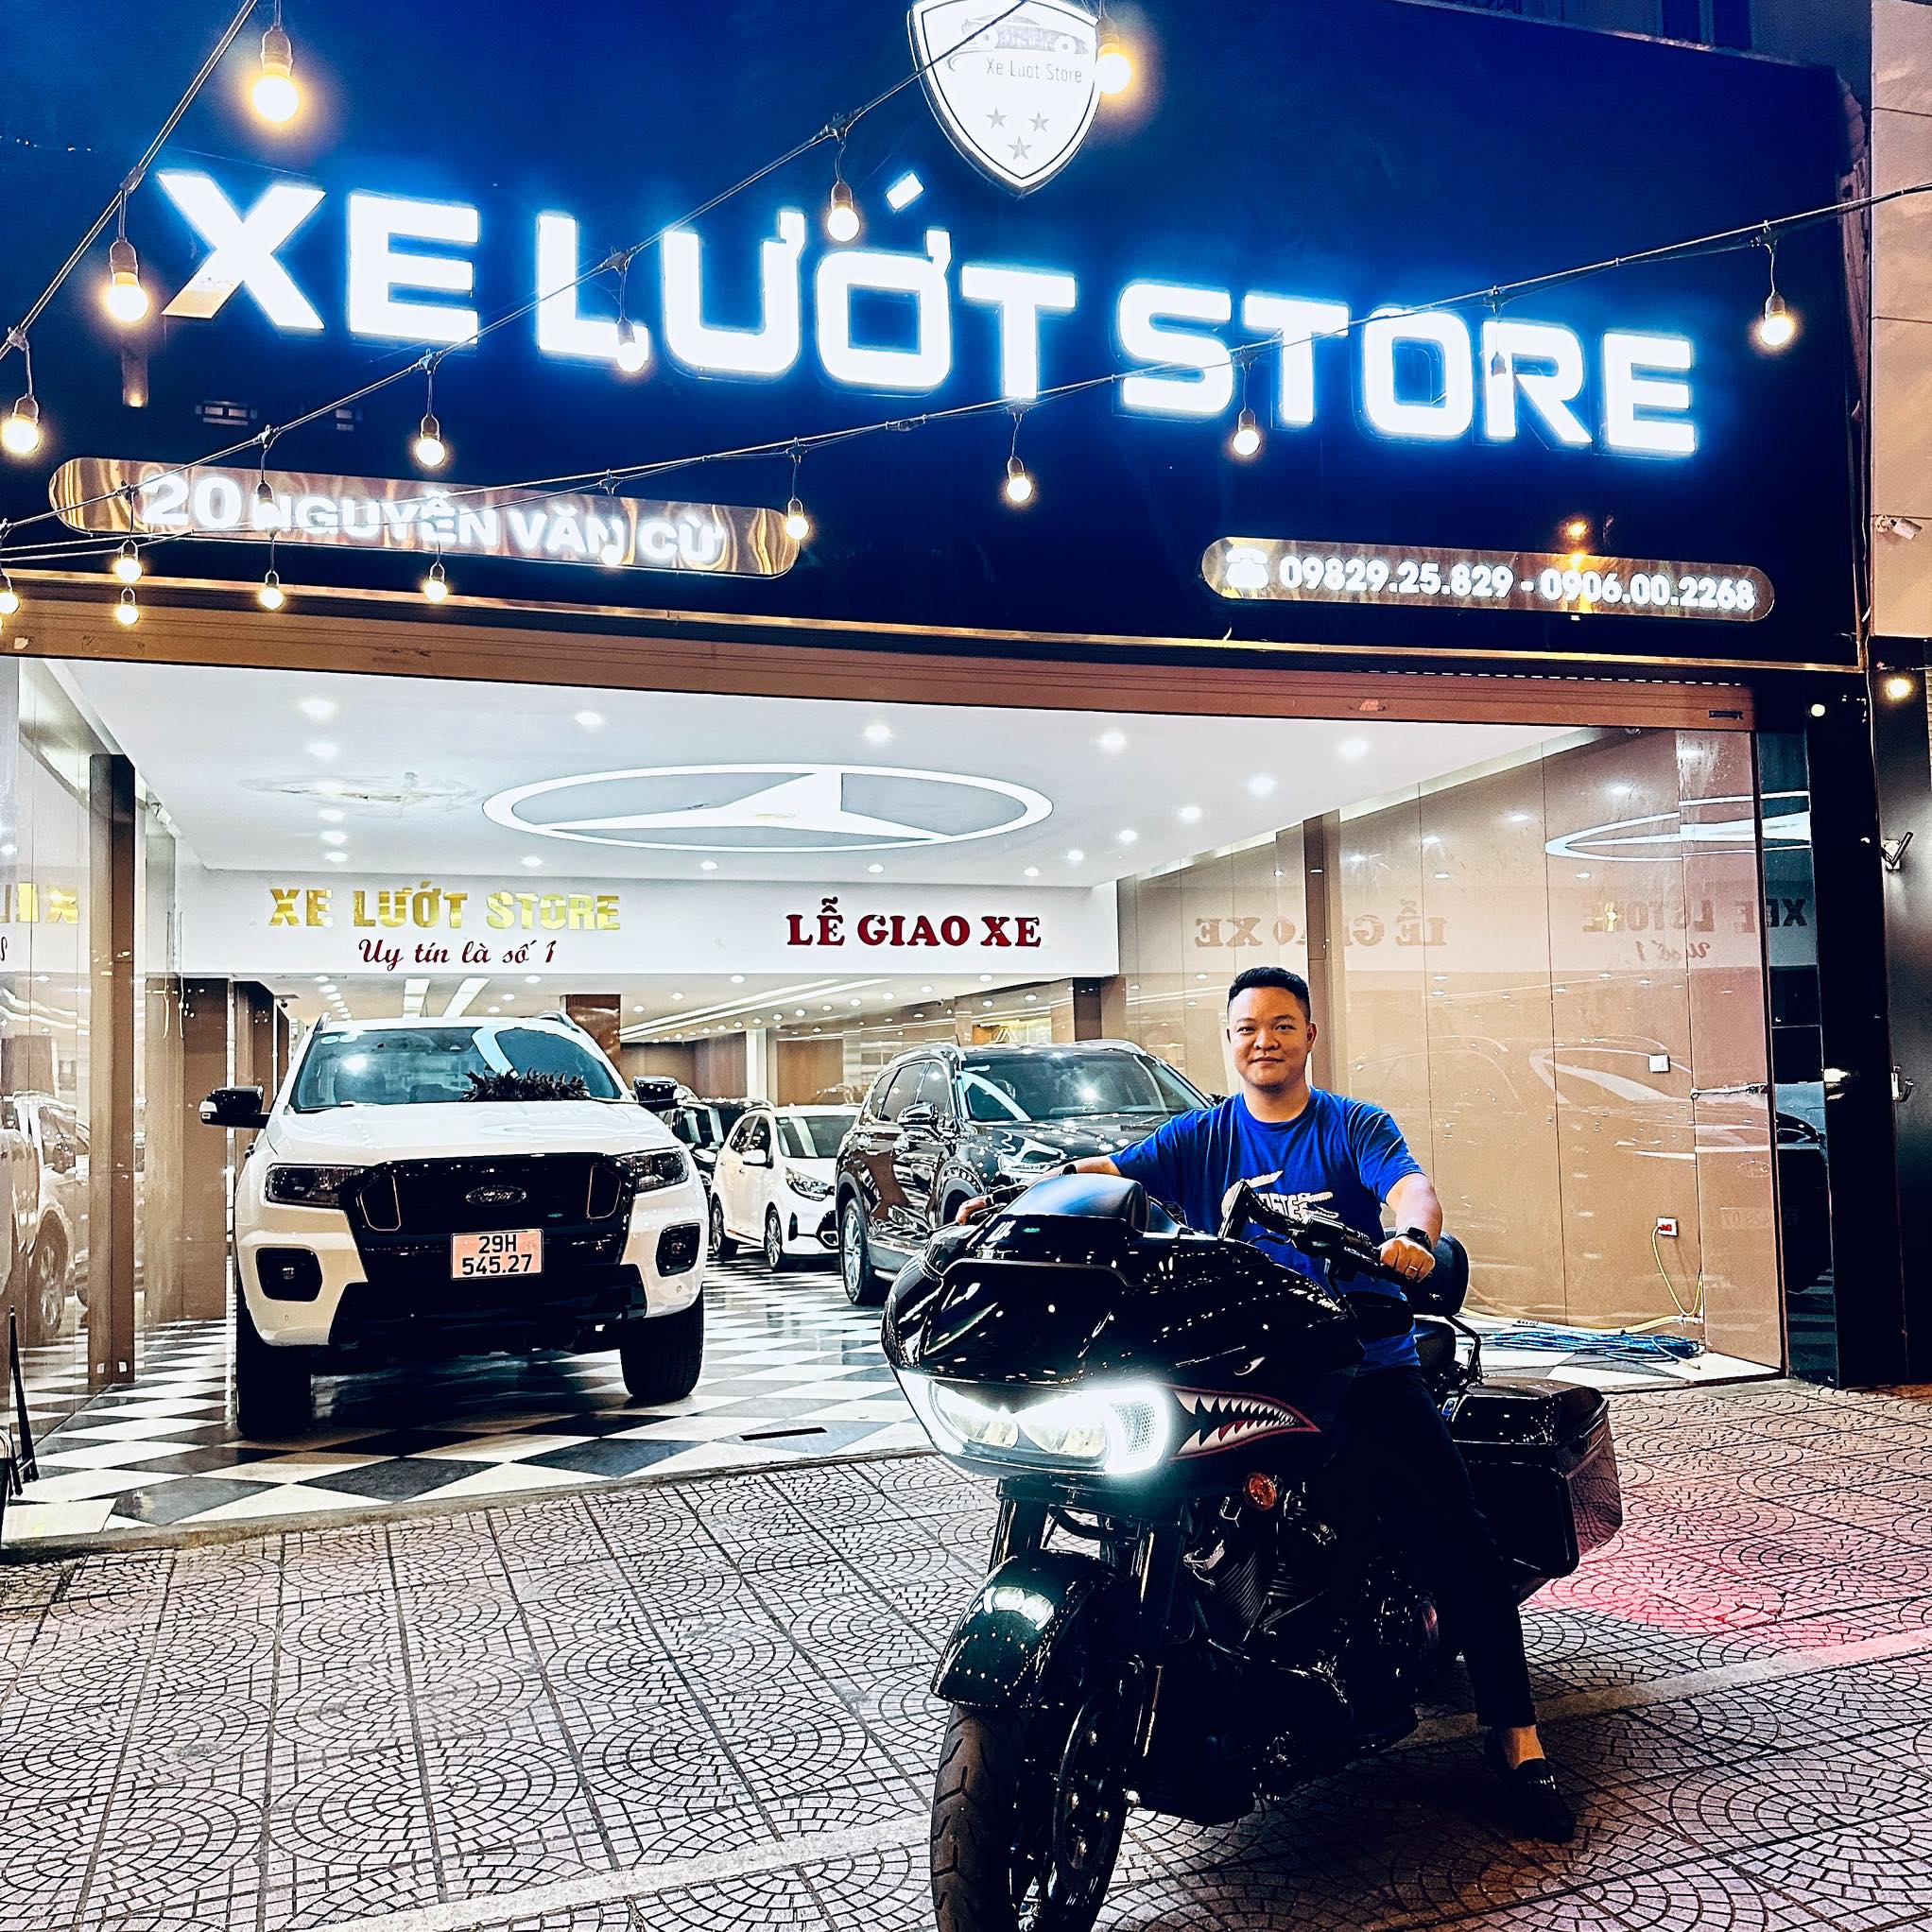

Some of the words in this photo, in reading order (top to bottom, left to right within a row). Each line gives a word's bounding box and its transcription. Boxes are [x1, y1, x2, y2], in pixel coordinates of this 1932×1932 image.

[986, 58, 1004, 76] Xe
[1045, 63, 1082, 83] Store
[156, 171, 480, 344] XE
[537, 172, 1077, 399] LƯỚT
[1118, 283, 1698, 454] STORE
[141, 473, 243, 530] 20
[507, 505, 625, 558] VĂN
[637, 514, 723, 563] CỪ
[1279, 555, 1514, 597] 09829.25.829
[1540, 567, 1756, 611] 0906.00.2268
[269, 888, 334, 927] XE
[354, 880, 468, 929] LƯỚT
[486, 891, 622, 931] STORE
[786, 896, 846, 946] LỄ
[857, 914, 971, 947] GIAO
[980, 916, 1042, 948] XE
[358, 939, 405, 971] Uy
[414, 941, 451, 963] tín
[461, 940, 492, 963] là
[502, 940, 538, 964] số
[544, 940, 558, 963] 1
[462, 1254, 532, 1275] 545.27
[478, 1234, 517, 1254] 29H
